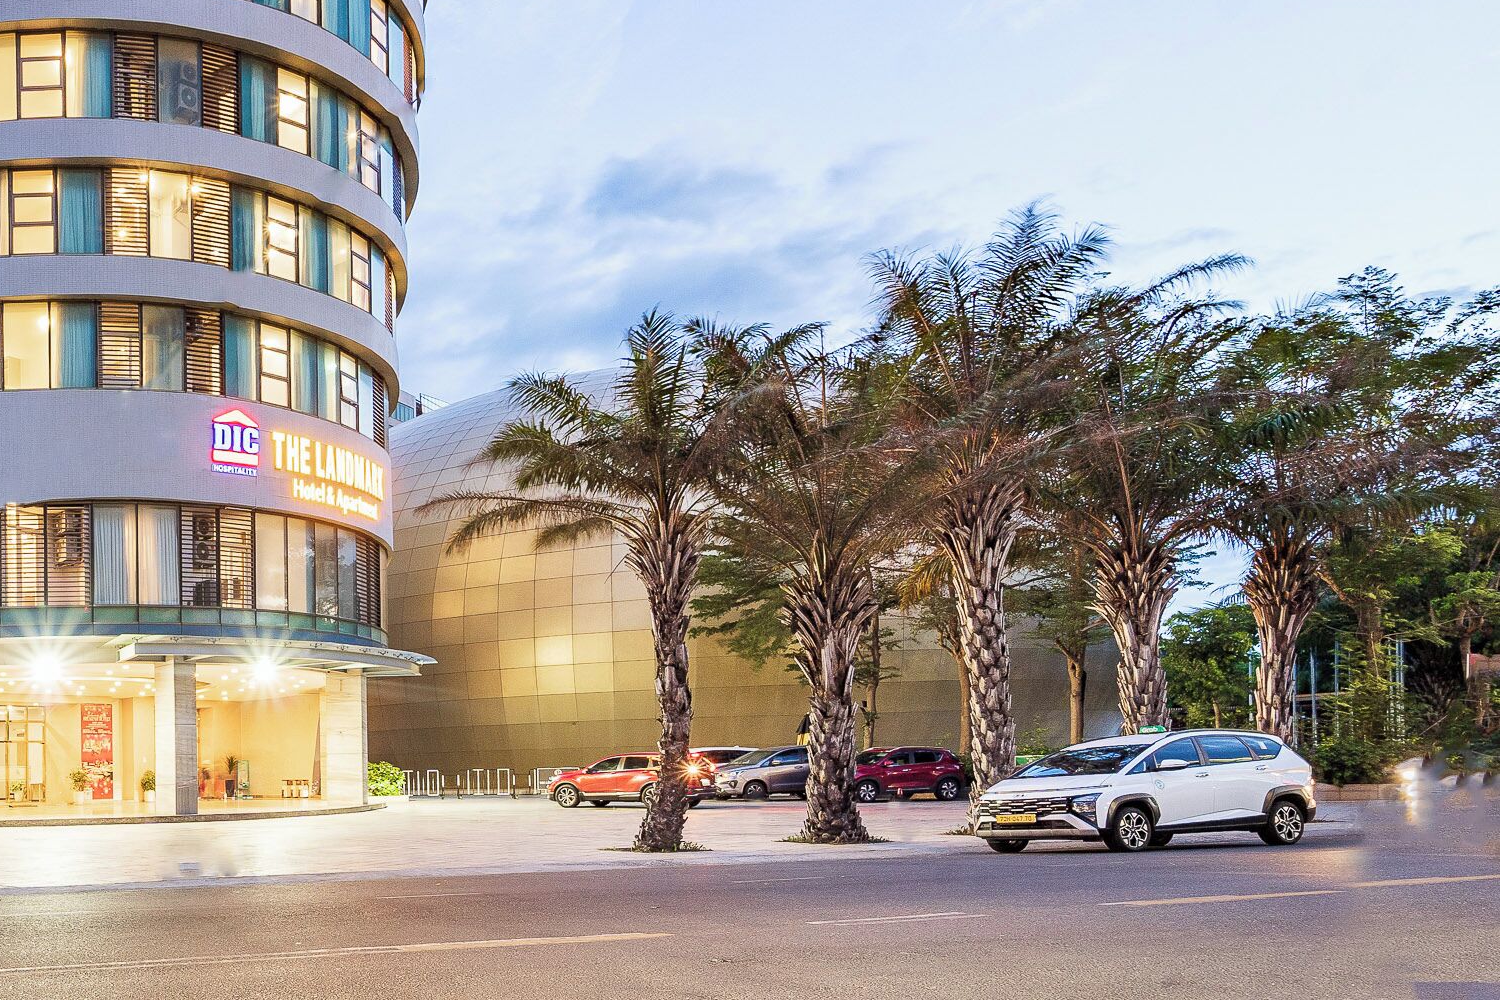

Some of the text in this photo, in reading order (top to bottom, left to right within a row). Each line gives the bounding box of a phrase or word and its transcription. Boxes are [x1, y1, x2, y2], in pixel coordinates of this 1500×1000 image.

[213, 422, 260, 454] DIC
[212, 464, 258, 477] HOSPITALITY
[272, 431, 384, 501] THE LANDMARK
[293, 477, 325, 503] Hotel
[326, 485, 336, 505] &
